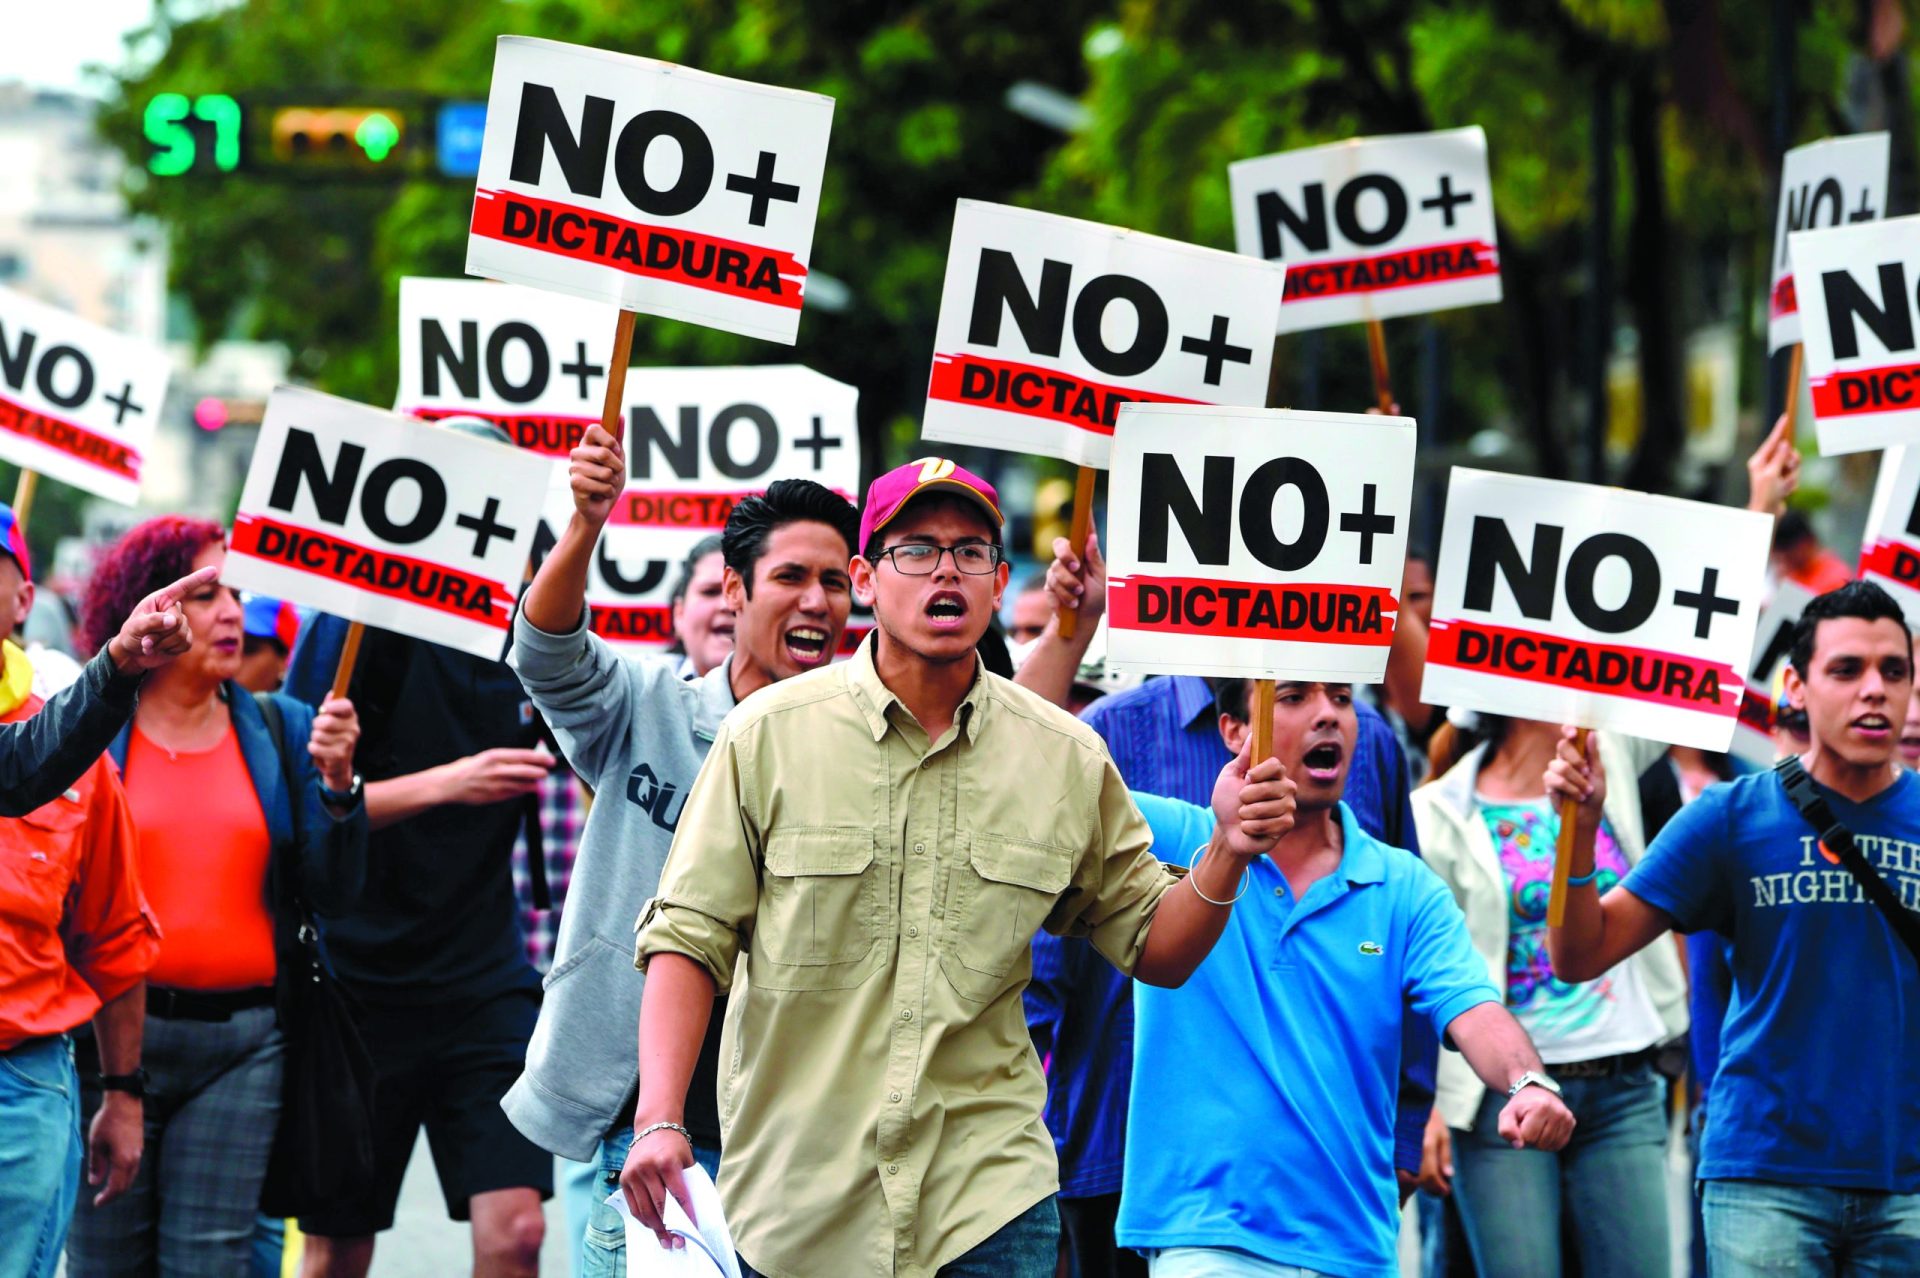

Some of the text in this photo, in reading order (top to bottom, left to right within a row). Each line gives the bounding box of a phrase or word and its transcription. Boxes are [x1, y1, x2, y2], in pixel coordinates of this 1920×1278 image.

[144, 92, 241, 176] 57
[502, 200, 783, 295] DICTADURA
[1282, 246, 1480, 296] ICTADURA
[256, 525, 494, 616] DICTADURA
[1137, 584, 1383, 634] DICTADURA
[1456, 629, 1722, 705] DICTADURA
